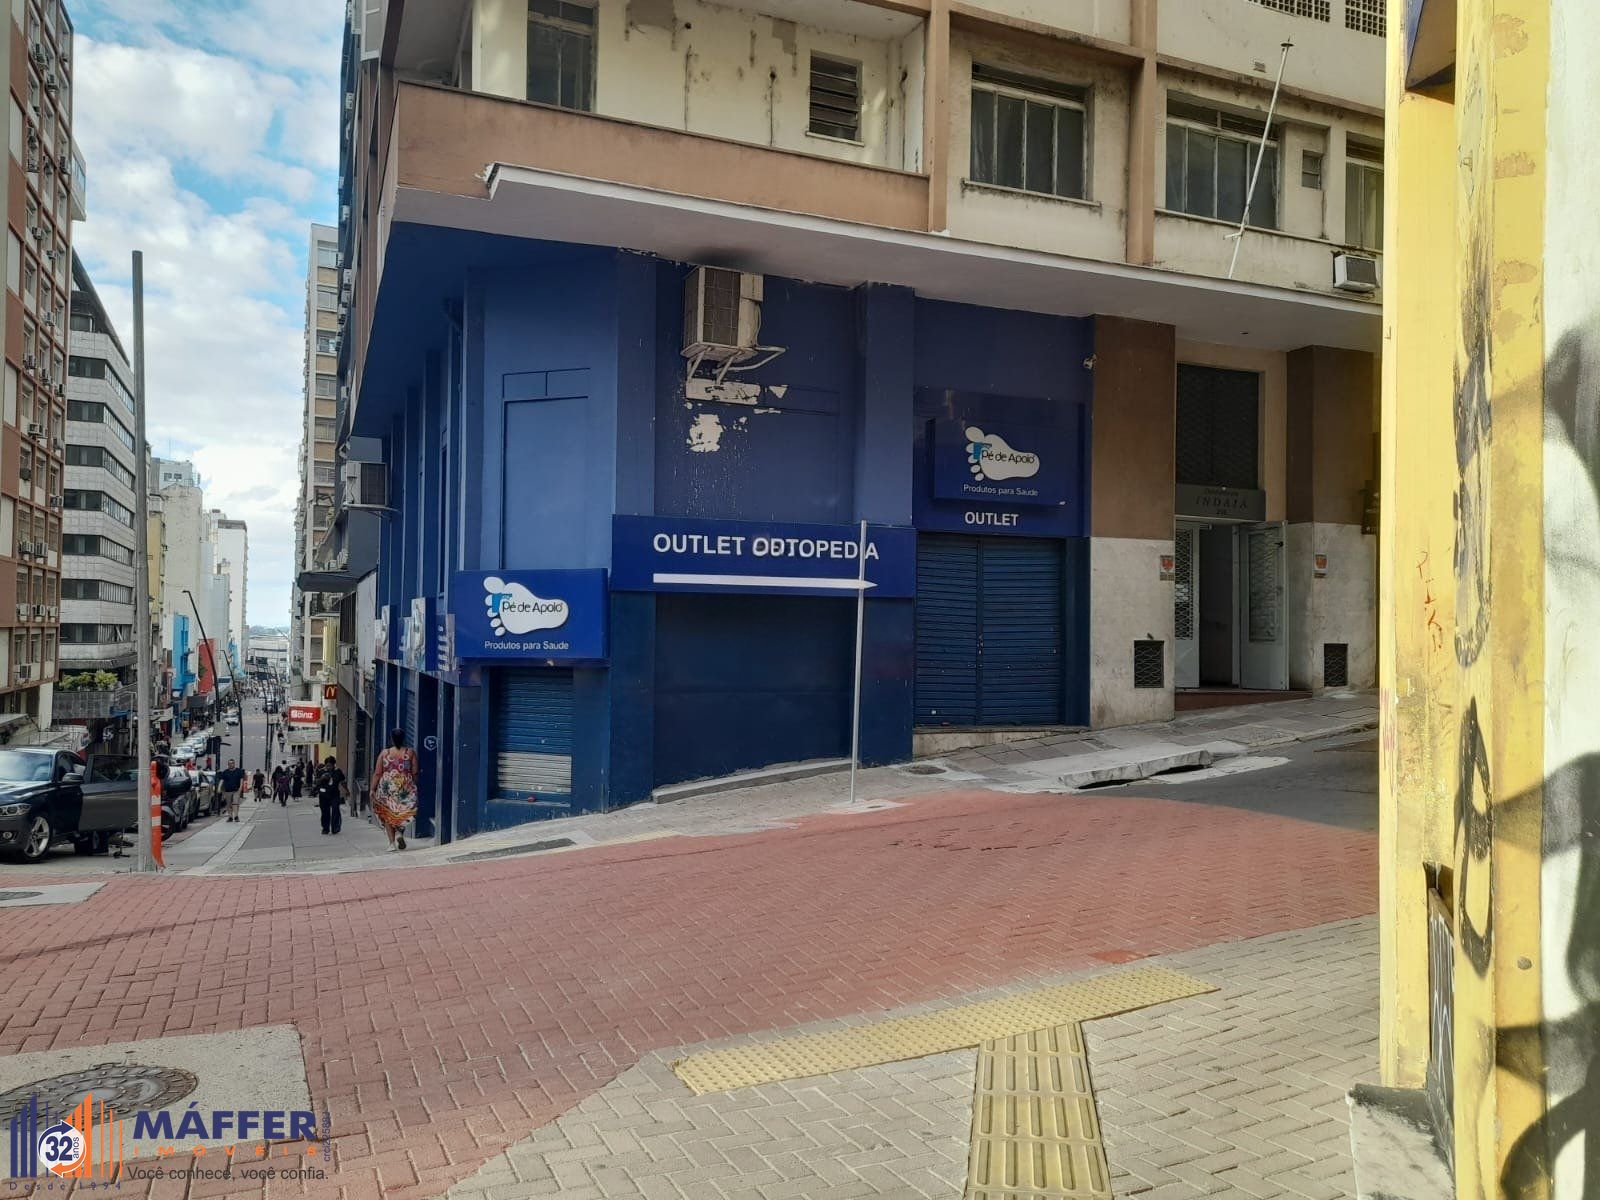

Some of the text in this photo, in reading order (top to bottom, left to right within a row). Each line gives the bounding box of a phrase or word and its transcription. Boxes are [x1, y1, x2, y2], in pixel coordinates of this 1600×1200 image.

[981, 449, 1035, 464] Pé de Apoio
[963, 484, 997, 494] Produtos
[998, 487, 1015, 496] para
[964, 511, 1019, 526] OUTLET
[653, 533, 746, 556] OUTLET
[502, 601, 563, 615] Pé de Apoio
[484, 640, 521, 650] Produtos
[522, 643, 541, 652] para
